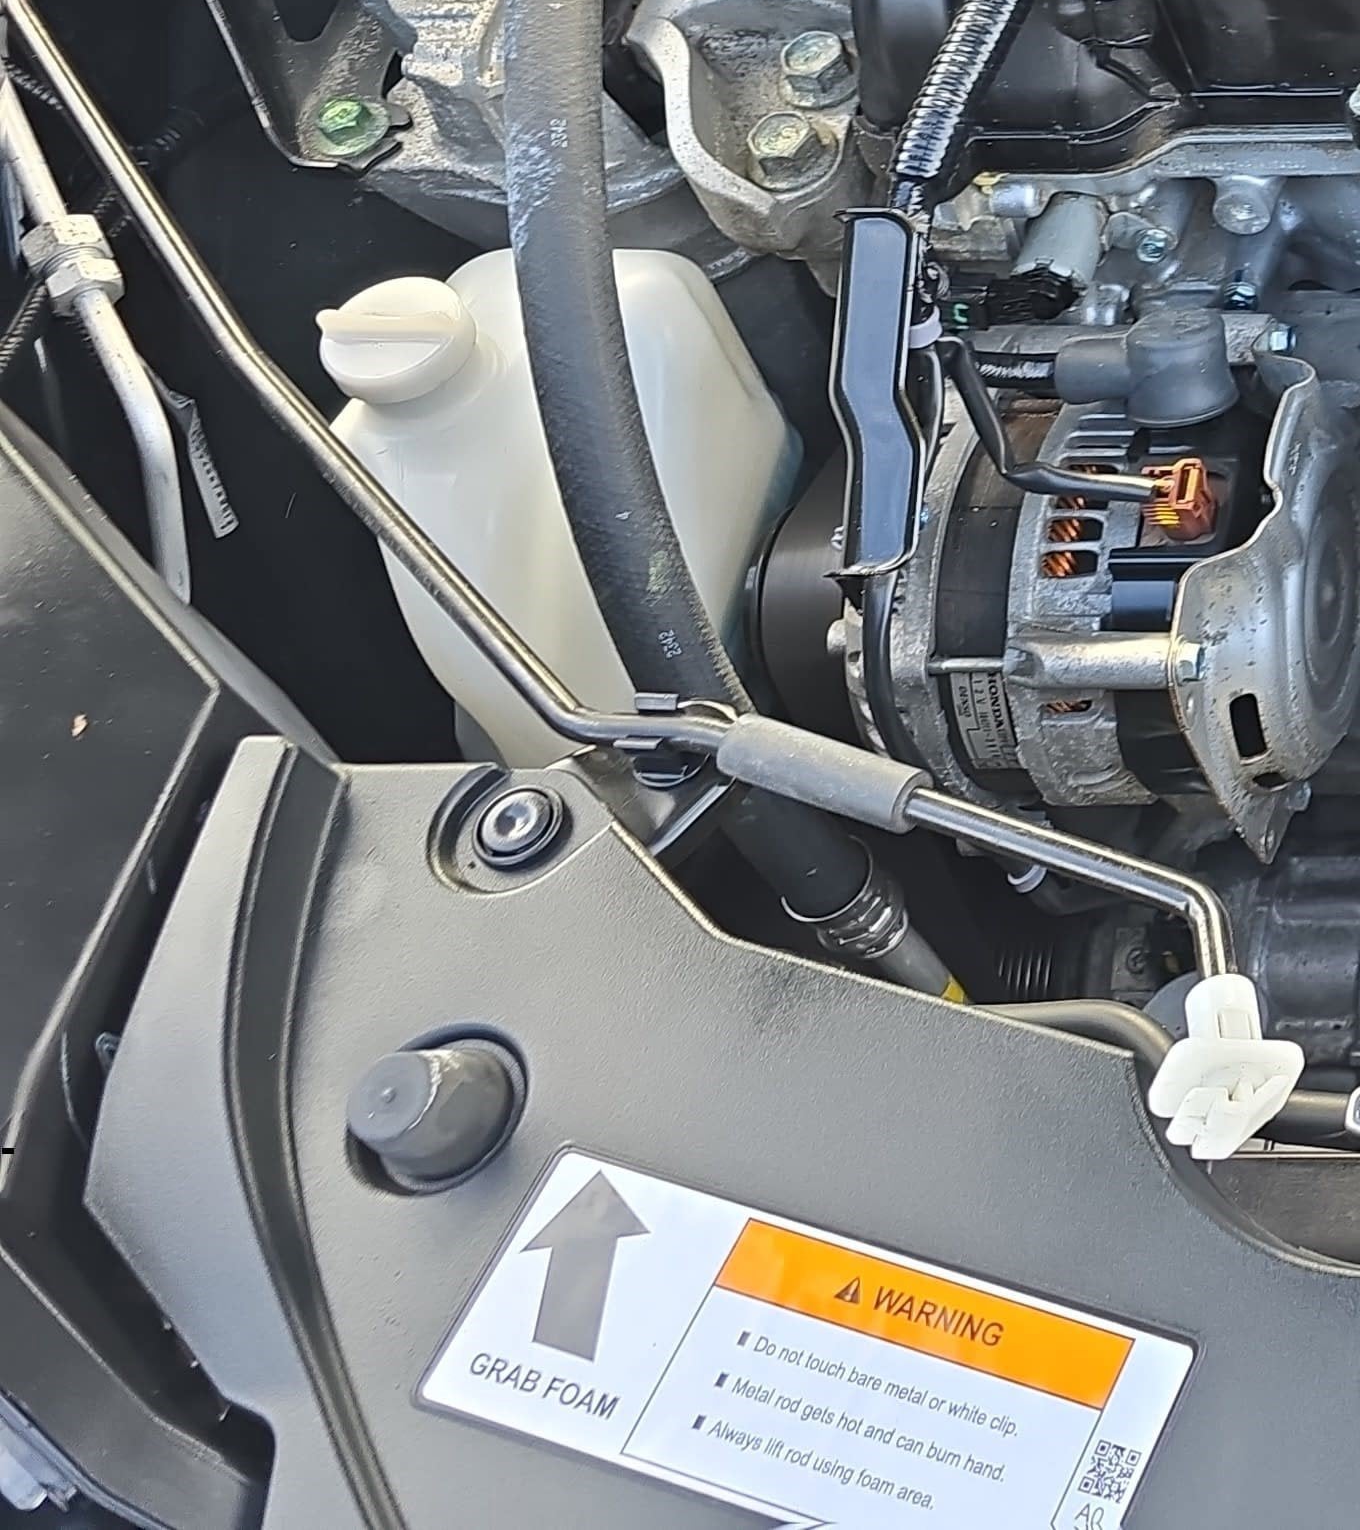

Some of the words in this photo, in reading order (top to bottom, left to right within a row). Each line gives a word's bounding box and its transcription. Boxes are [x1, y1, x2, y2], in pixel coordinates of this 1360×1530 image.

[988, 672, 1004, 728] HONDA
[873, 1285, 1004, 1347] WARNING
[470, 1353, 541, 1393] GRAB
[542, 1376, 620, 1420] FOAM
[754, 1336, 777, 1356] Do
[778, 1347, 803, 1366] not
[805, 1352, 847, 1380] touch
[847, 1366, 883, 1391] bare
[884, 1381, 929, 1406] metal
[929, 1396, 946, 1412] or
[949, 1401, 988, 1426] white
[990, 1415, 1019, 1438] clip.
[707, 1419, 763, 1452] Always
[763, 1437, 786, 1459] lift
[784, 1449, 814, 1467] rod
[813, 1457, 854, 1485] using
[856, 1468, 895, 1497] foam
[897, 1485, 936, 1511] area.
[732, 1377, 776, 1405] Metal
[774, 1395, 803, 1414] rod
[800, 1404, 836, 1425] gets
[836, 1411, 865, 1435] hot
[864, 1427, 897, 1445] and
[896, 1434, 927, 1456] can
[926, 1441, 962, 1467] burn
[963, 1454, 1006, 1482] hand.
